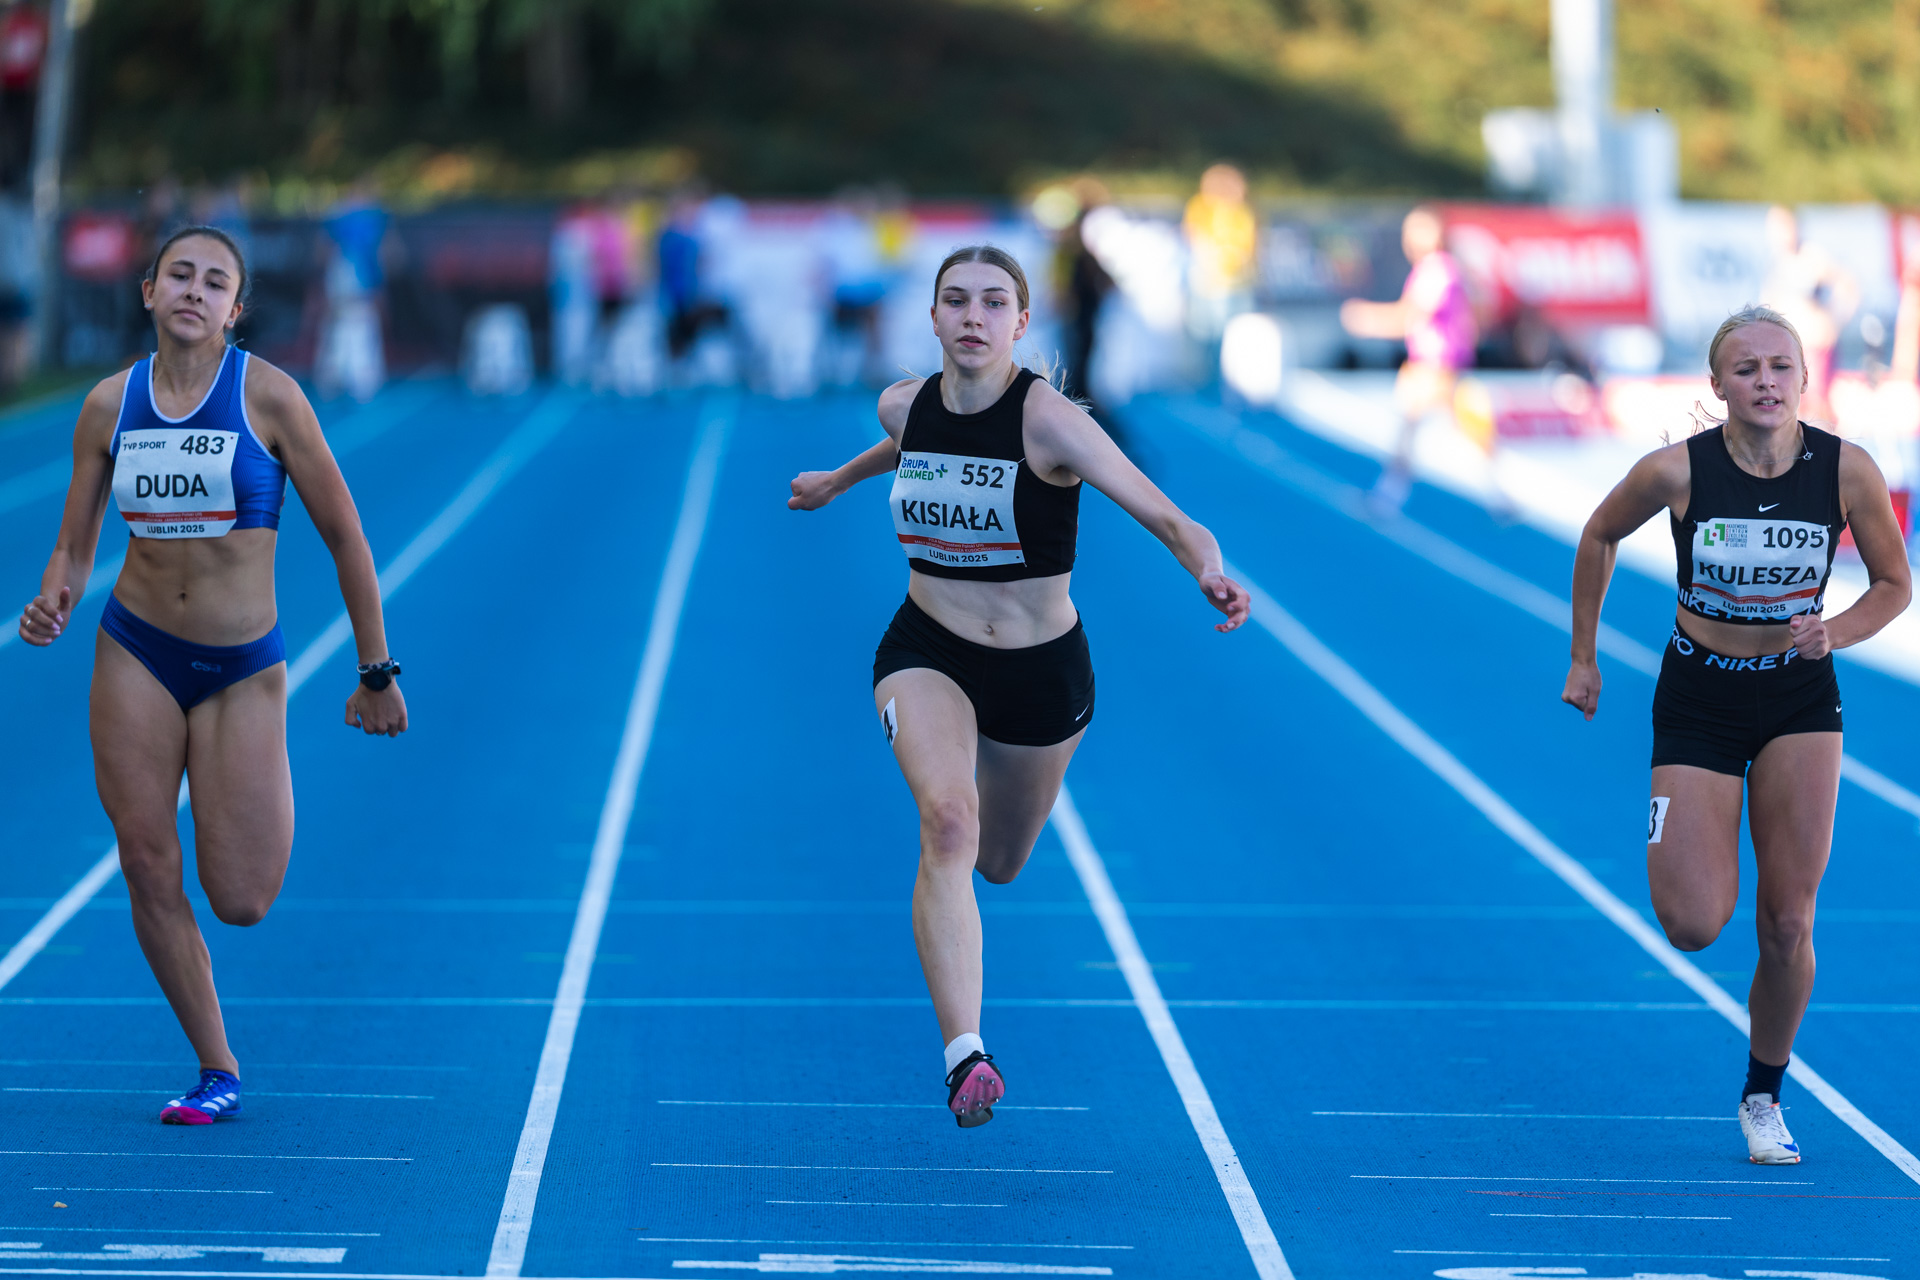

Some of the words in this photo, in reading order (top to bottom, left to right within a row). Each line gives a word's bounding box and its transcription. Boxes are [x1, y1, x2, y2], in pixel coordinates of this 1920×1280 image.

[123, 443, 137, 451] TVP
[138, 441, 166, 449] SPORT
[180, 435, 225, 455] 483
[901, 458, 930, 470] GRUPA
[899, 469, 934, 481] LUXMED
[960, 463, 1005, 489] 552
[136, 474, 209, 498] DUDA
[901, 499, 1004, 531] KISIAŁA
[147, 525, 178, 534] LUBLIN
[180, 525, 205, 533] 2025
[1762, 526, 1824, 549] 1095
[929, 549, 960, 563] LUBLIN
[961, 554, 989, 563] 2025
[1699, 561, 1817, 585] KULESZA
[1722, 600, 1758, 614] LUBLIN
[1760, 603, 1787, 614] 2025
[1705, 653, 1780, 671] NIKE
[1648, 800, 1659, 841] 3
